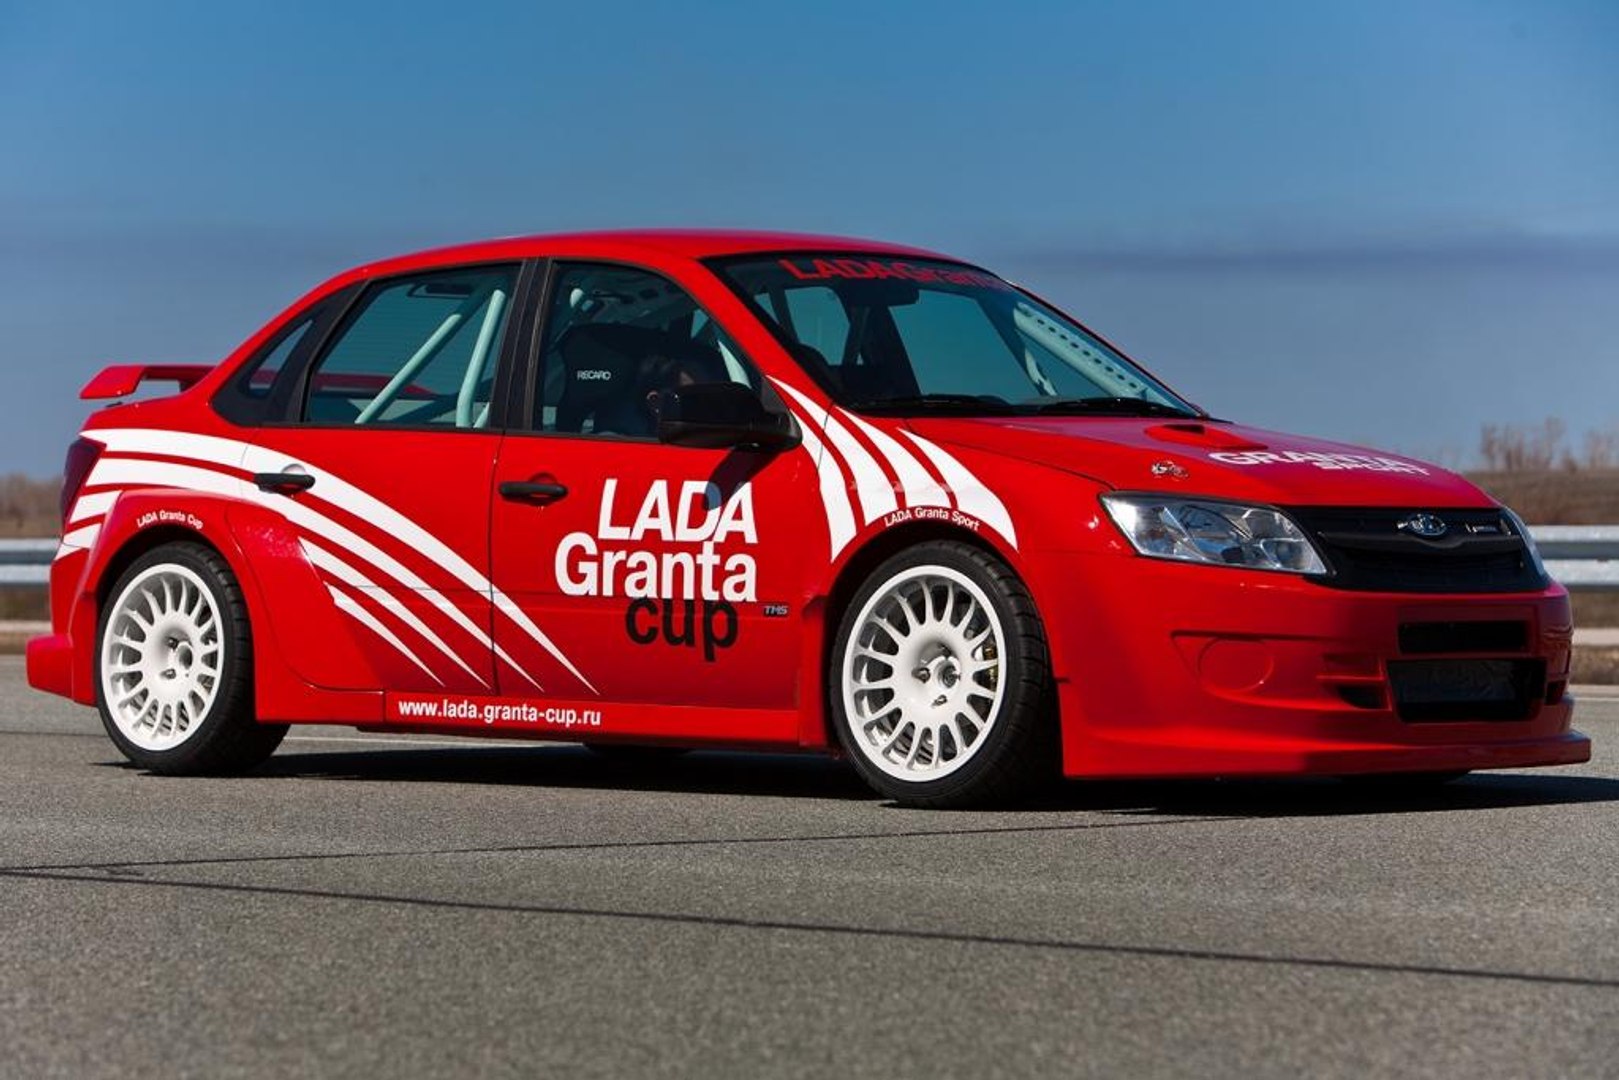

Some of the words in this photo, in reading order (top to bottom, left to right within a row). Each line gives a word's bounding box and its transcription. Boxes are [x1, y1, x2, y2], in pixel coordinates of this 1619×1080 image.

[780, 258, 890, 280] LADA
[577, 370, 612, 381] RECARO
[136, 511, 158, 528] LADA
[159, 509, 186, 522] Granta
[187, 514, 203, 530] Cup
[597, 478, 758, 544] LADA
[884, 509, 912, 527] LADA
[914, 507, 949, 520] Granta
[951, 510, 980, 532] Sport
[554, 531, 758, 602] Granta
[625, 597, 738, 663] cup
[398, 698, 601, 728] www.lada.granta-cup.ru
